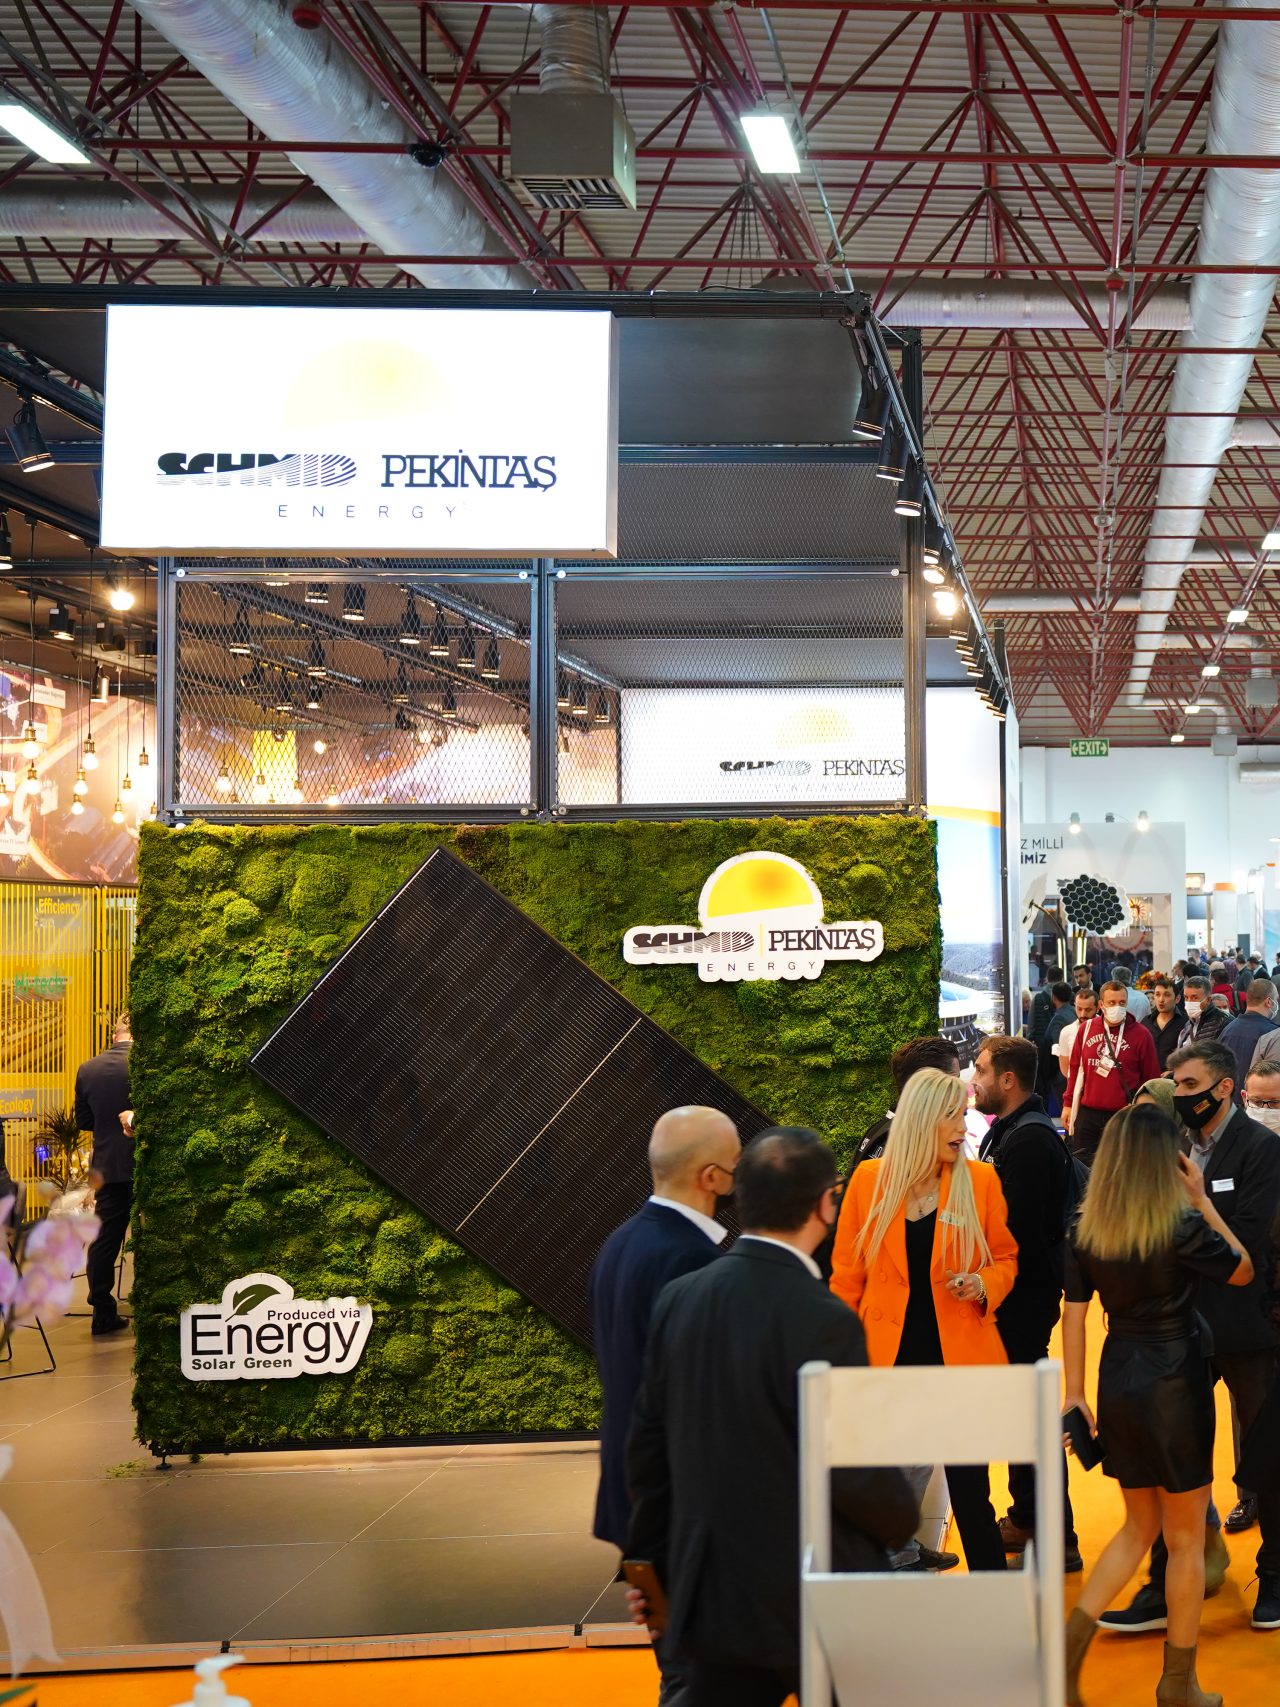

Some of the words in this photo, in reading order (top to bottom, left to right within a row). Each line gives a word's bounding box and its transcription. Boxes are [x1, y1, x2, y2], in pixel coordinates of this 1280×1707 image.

[157, 452, 358, 487] SCHMID
[380, 449, 558, 492] PEKİNTAŞ
[278, 504, 457, 518] ENERGY
[1078, 740, 1101, 755] EXIT
[38, 897, 81, 917] Efficiency
[632, 931, 755, 955] SCHMID
[768, 925, 876, 952] PEKİNTAŞ
[707, 961, 816, 972] ENERGY
[267, 1309, 335, 1321] Produced
[340, 1308, 361, 1318] via
[191, 1313, 361, 1364] Energy
[192, 1358, 236, 1370] Solar
[244, 1357, 292, 1369] Green
